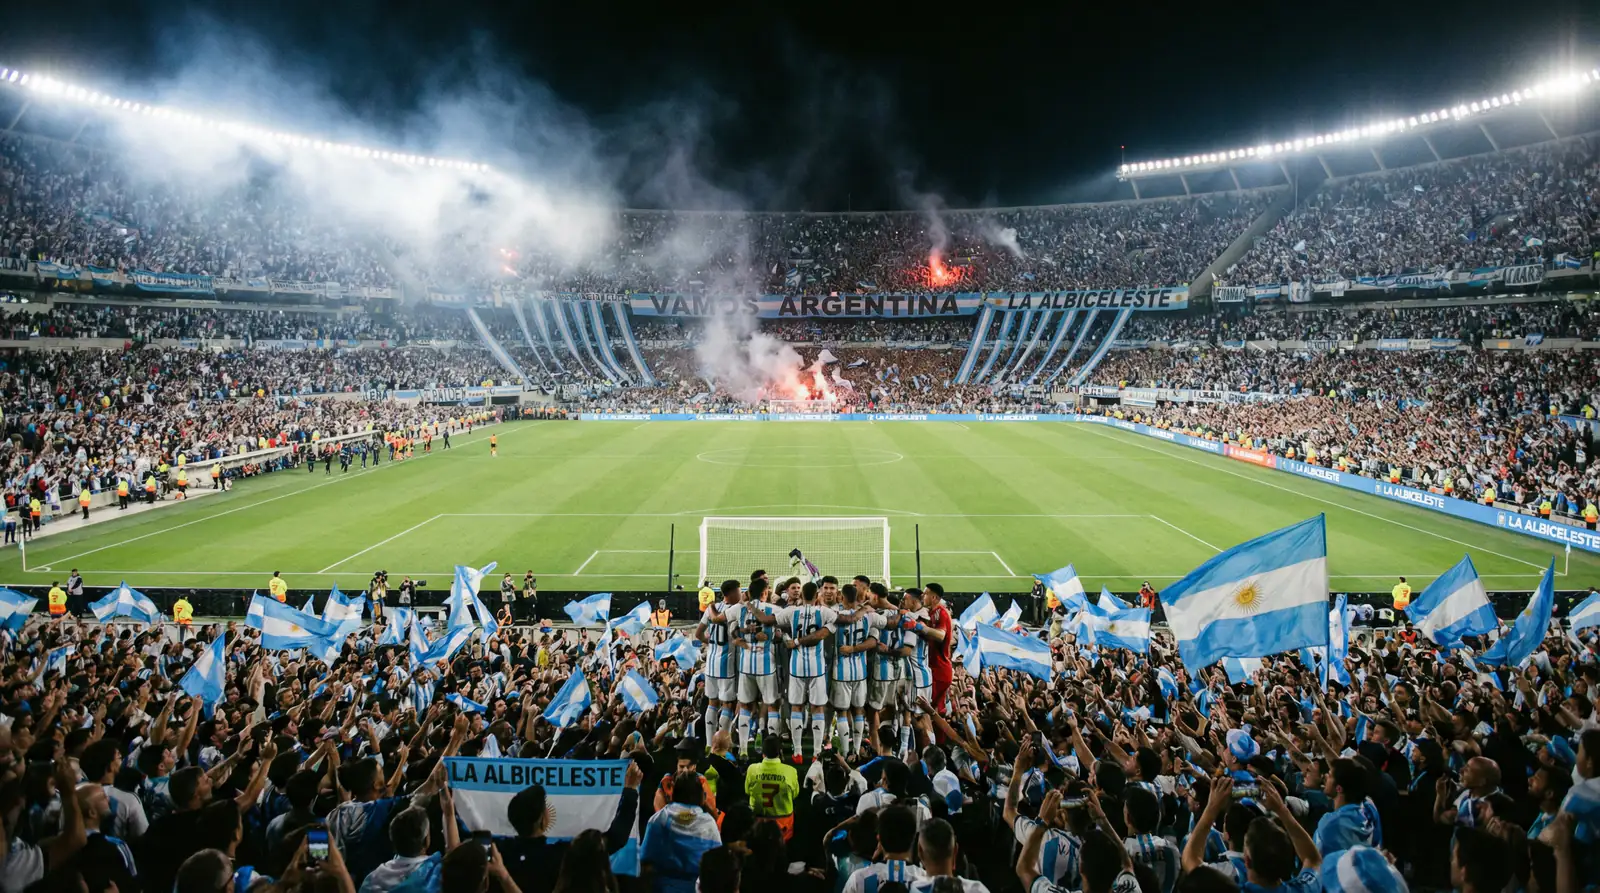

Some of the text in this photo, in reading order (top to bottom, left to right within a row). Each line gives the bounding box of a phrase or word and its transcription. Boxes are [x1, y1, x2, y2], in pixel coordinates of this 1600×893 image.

[650, 295, 760, 316] VAMOS
[778, 295, 960, 317] ARGENTINA
[1007, 289, 1172, 310] LA ALBICELESTE
[1296, 463, 1304, 473] LA
[1383, 486, 1444, 508] LA ALBICELESTE
[1508, 515, 1600, 548] LA ALBICELESTE
[451, 761, 623, 787] LA ALBICELESTE
